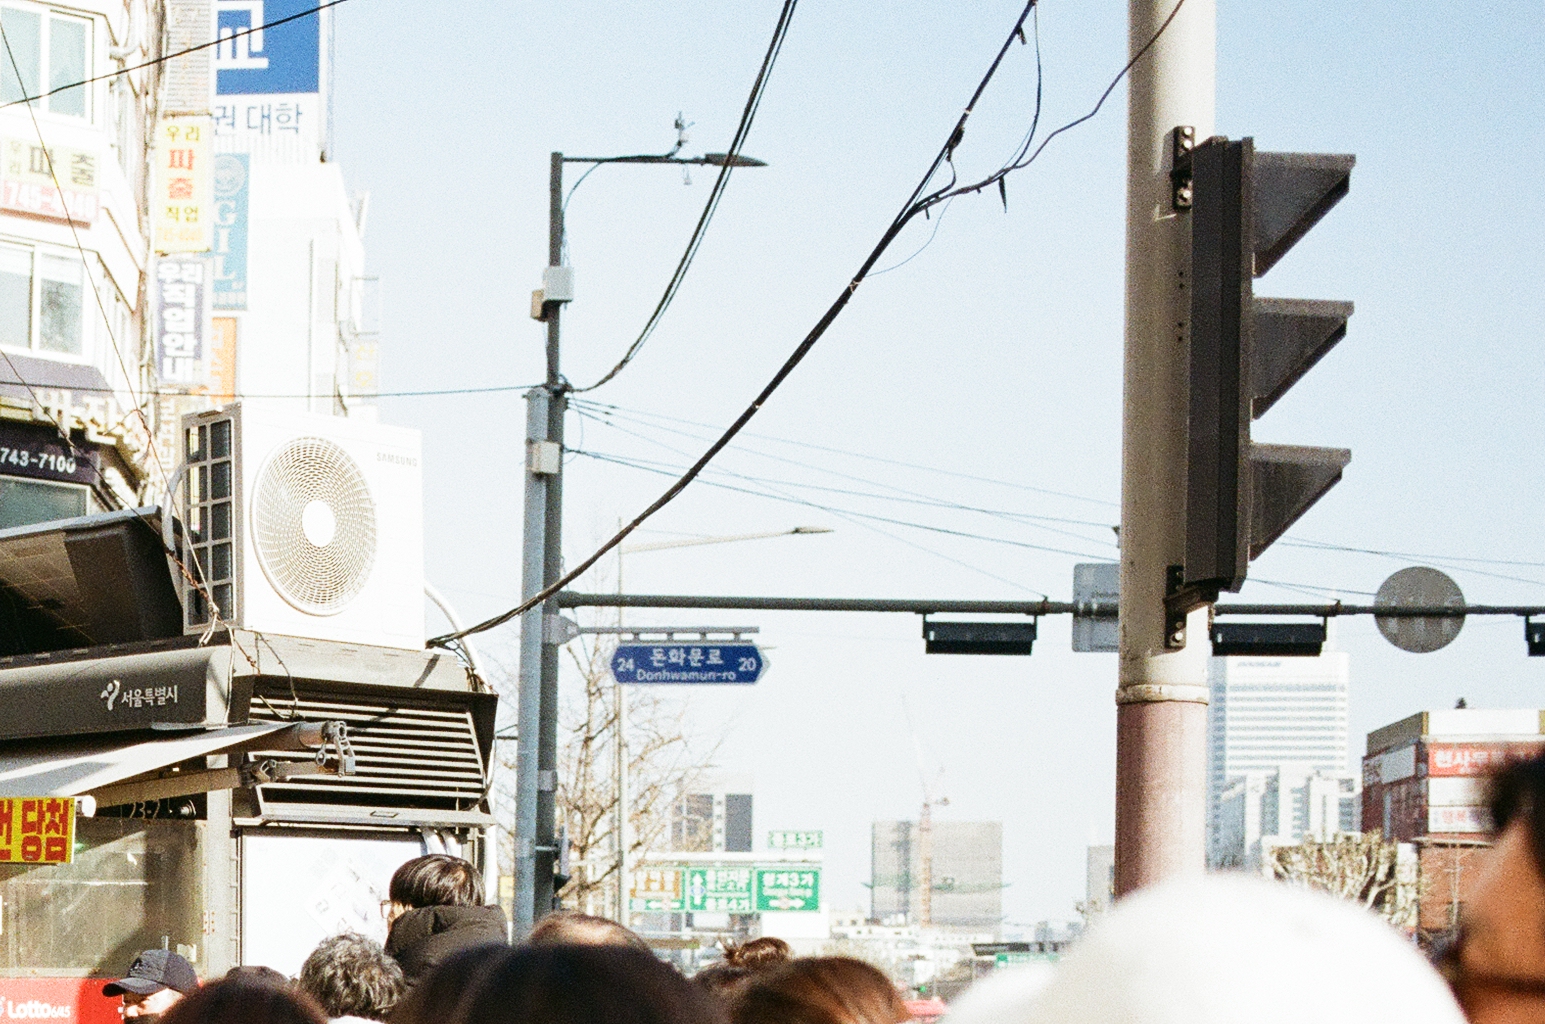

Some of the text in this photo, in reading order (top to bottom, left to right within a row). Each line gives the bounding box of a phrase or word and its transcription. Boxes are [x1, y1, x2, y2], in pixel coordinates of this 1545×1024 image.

[246, 102, 303, 136] 대학
[167, 148, 196, 200] 파출
[164, 205, 200, 223] 직업
[0, 447, 76, 474] 743-7100
[376, 451, 417, 467] SAMSUNG
[617, 657, 635, 672] 24
[649, 648, 724, 668] 돈화문로
[738, 656, 756, 672] 20
[636, 668, 736, 682] Donhwamun-ro
[120, 684, 178, 708] 서울특별시
[21, 801, 68, 862] 당첨
